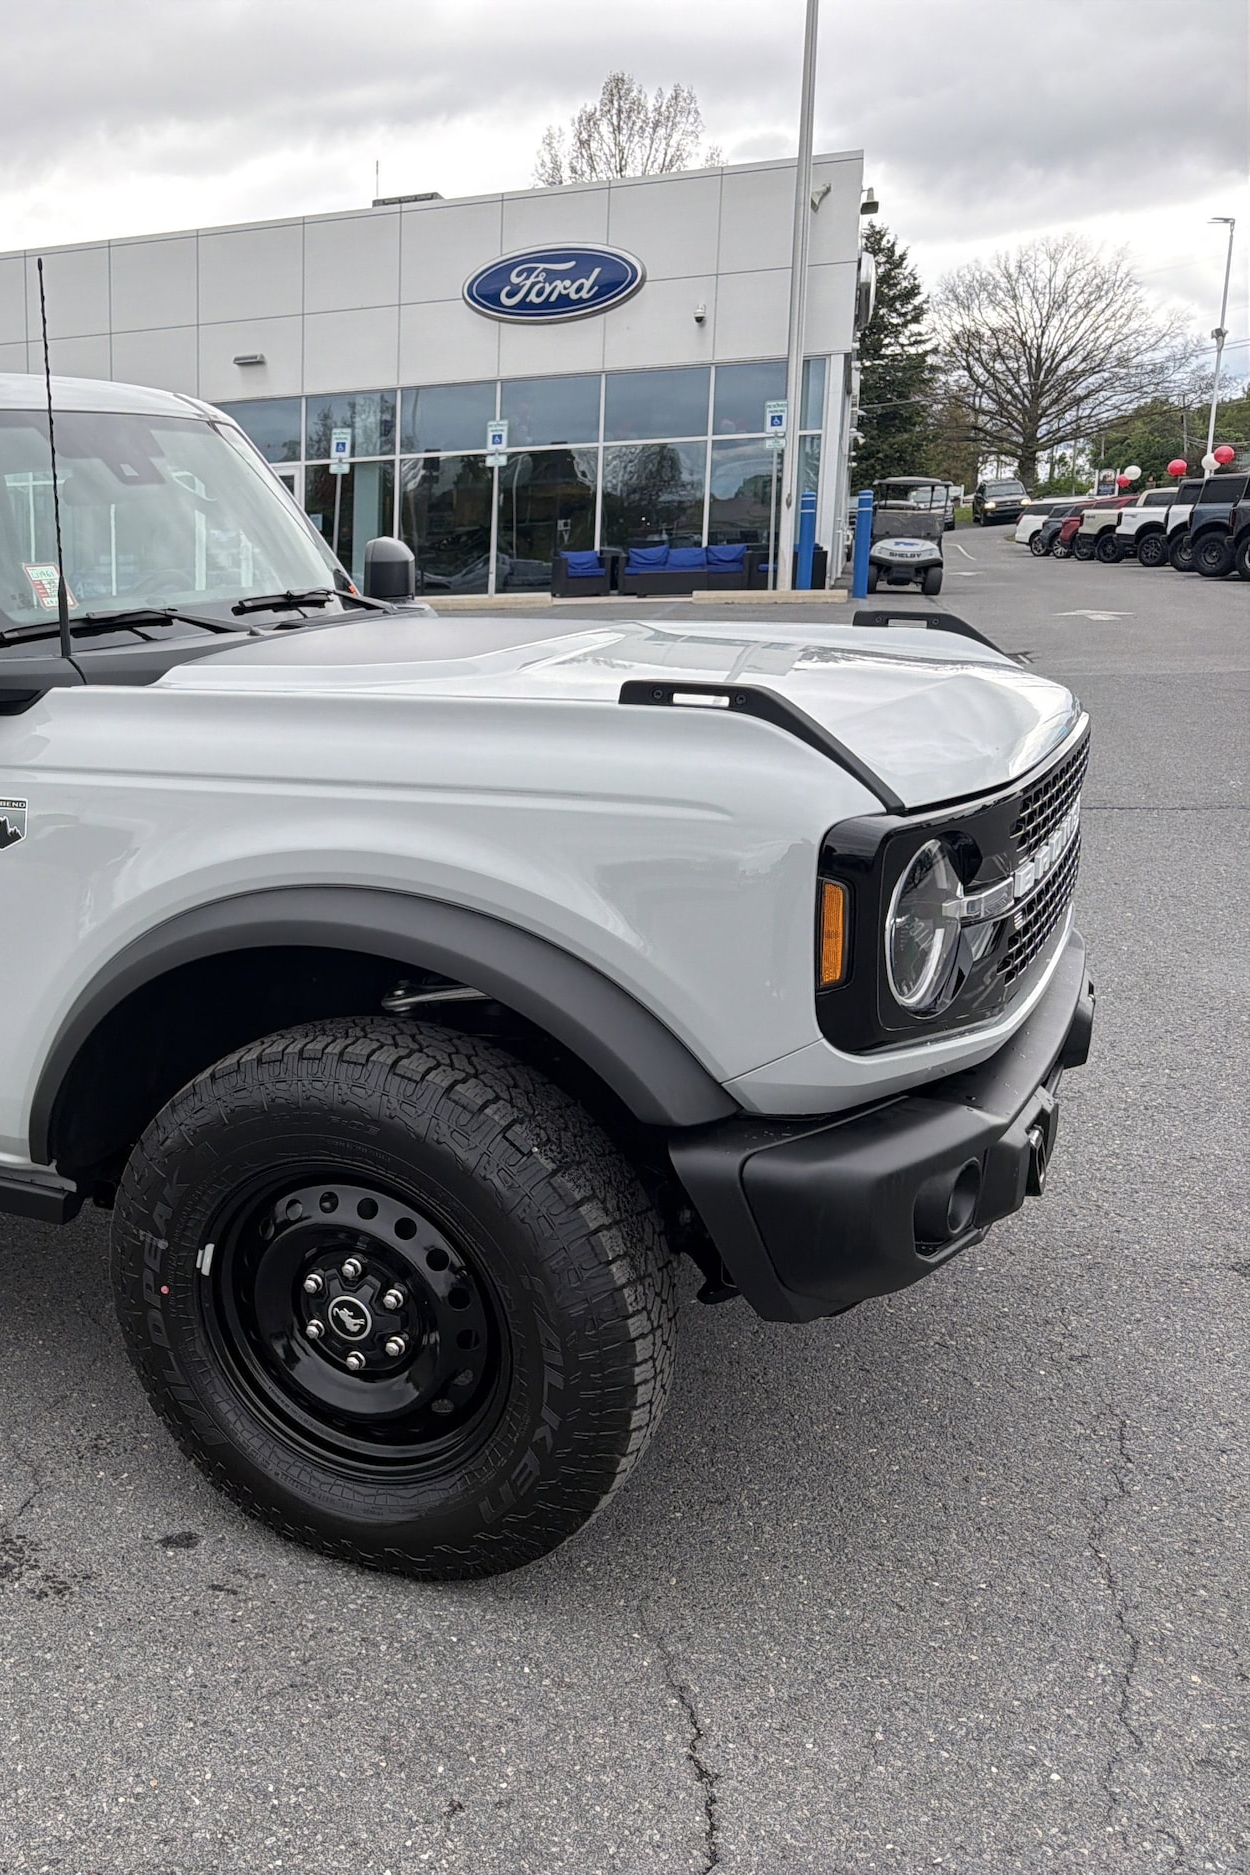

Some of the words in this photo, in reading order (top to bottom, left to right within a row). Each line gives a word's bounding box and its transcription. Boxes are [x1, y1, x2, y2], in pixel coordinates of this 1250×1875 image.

[500, 260, 602, 307] Ford
[889, 551, 923, 559] SHELBY
[0, 800, 26, 808] BEND
